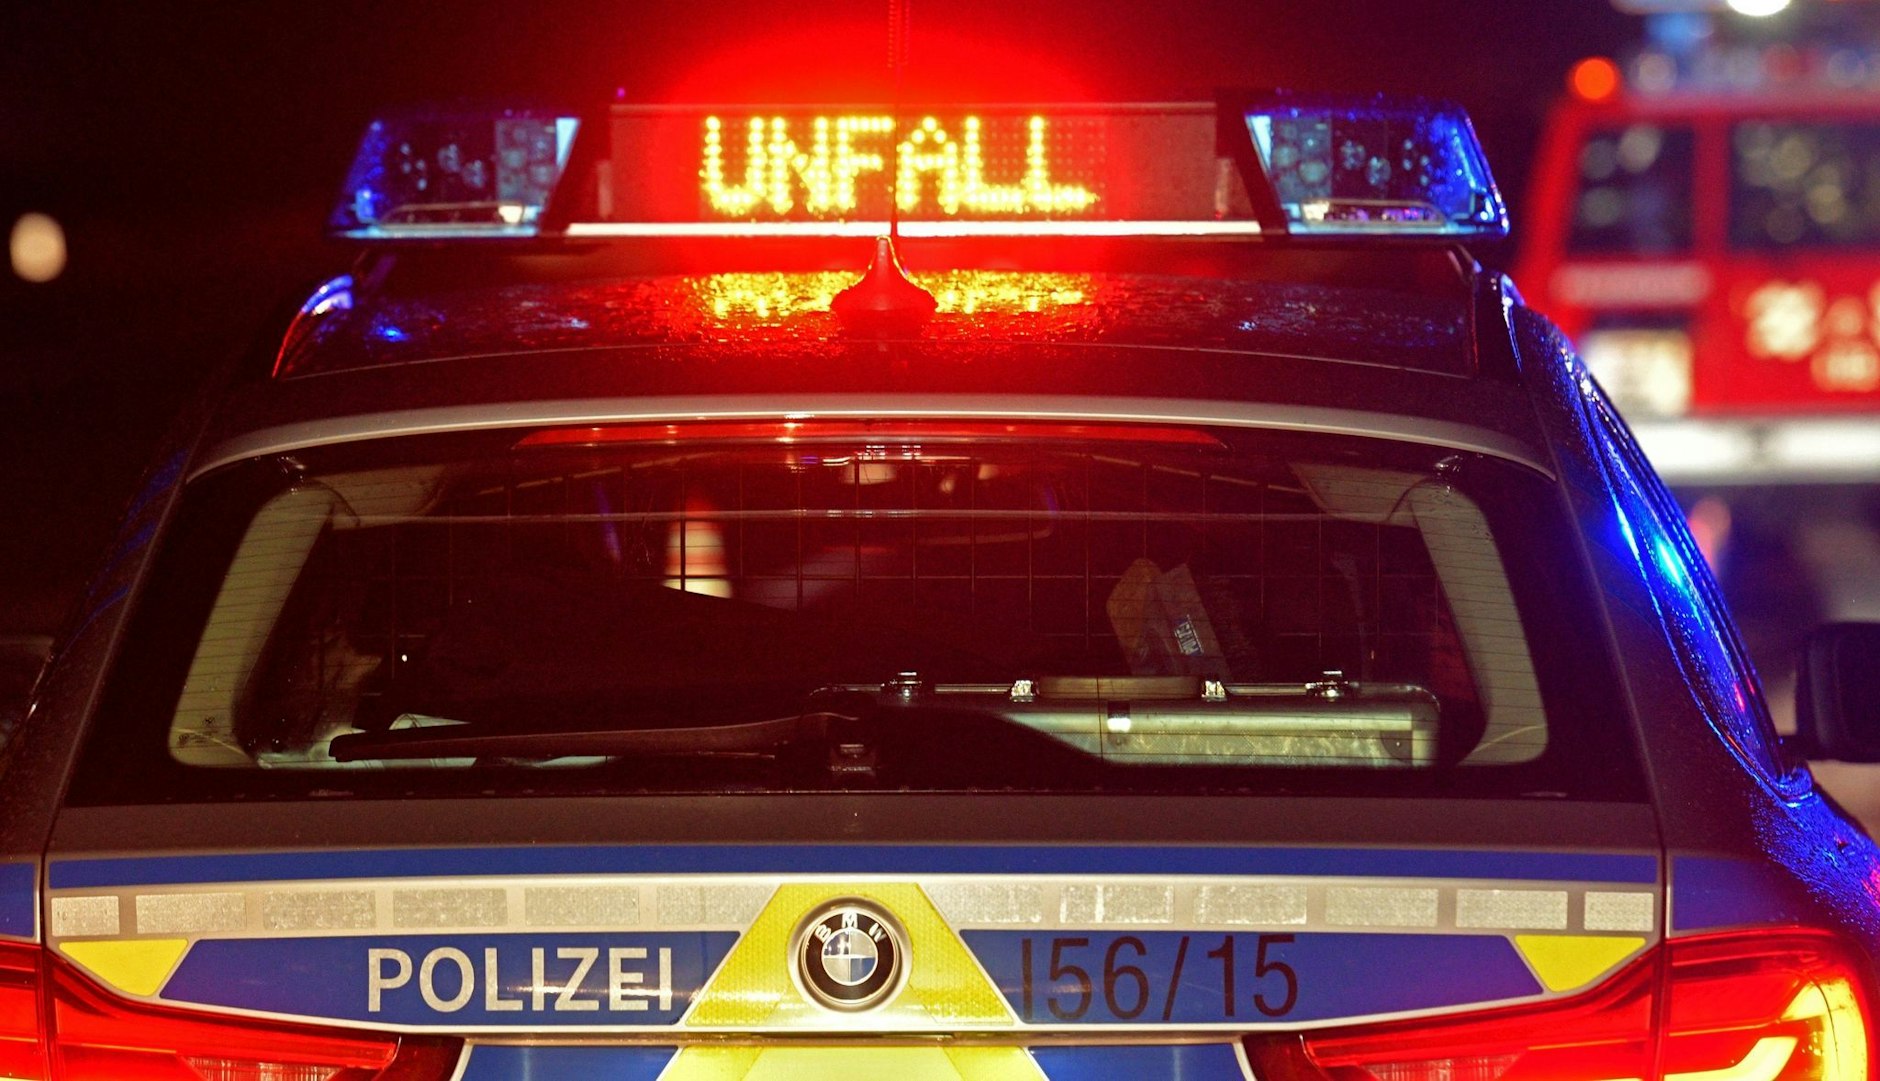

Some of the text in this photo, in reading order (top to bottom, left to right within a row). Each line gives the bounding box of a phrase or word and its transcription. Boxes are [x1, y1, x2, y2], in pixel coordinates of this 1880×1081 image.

[702, 114, 1095, 213] UNFALL
[814, 911, 887, 943] BMW
[367, 946, 672, 1013] POLIZEI
